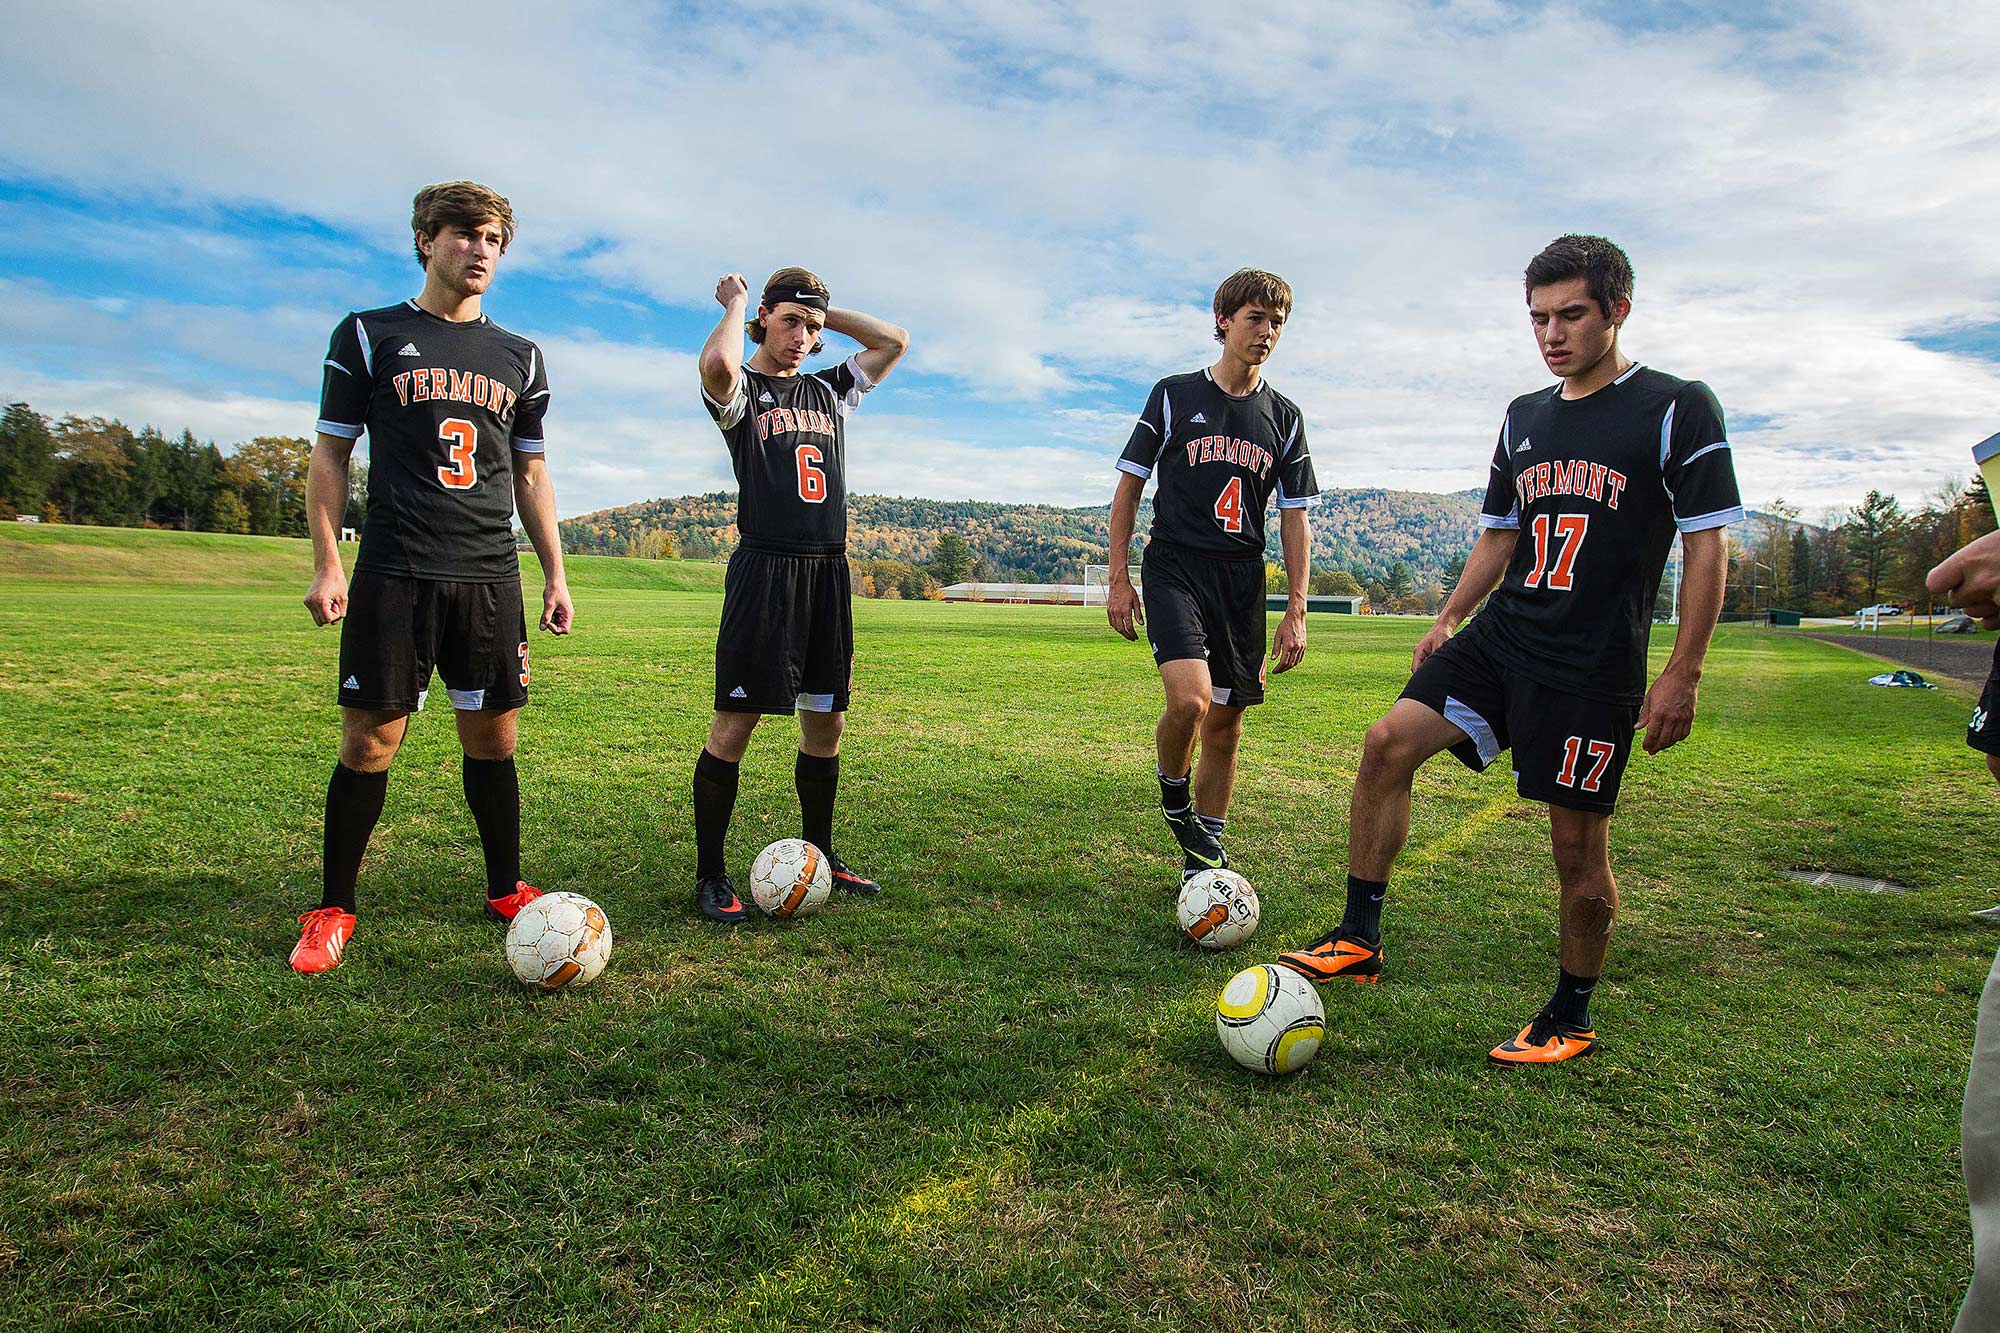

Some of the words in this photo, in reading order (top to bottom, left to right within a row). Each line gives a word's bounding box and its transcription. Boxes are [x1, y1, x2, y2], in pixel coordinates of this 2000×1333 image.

[393, 368, 517, 421] VERMONT
[437, 417, 478, 490] 3
[795, 444, 828, 503] 6
[1187, 435, 1273, 480] VERMONT
[1214, 476, 1243, 533] 4
[1516, 459, 1627, 511] VERMONT
[1524, 513, 1590, 591] 17
[518, 641, 530, 687] 3
[1556, 735, 1615, 792] 17
[1212, 880, 1252, 921] SELECT
